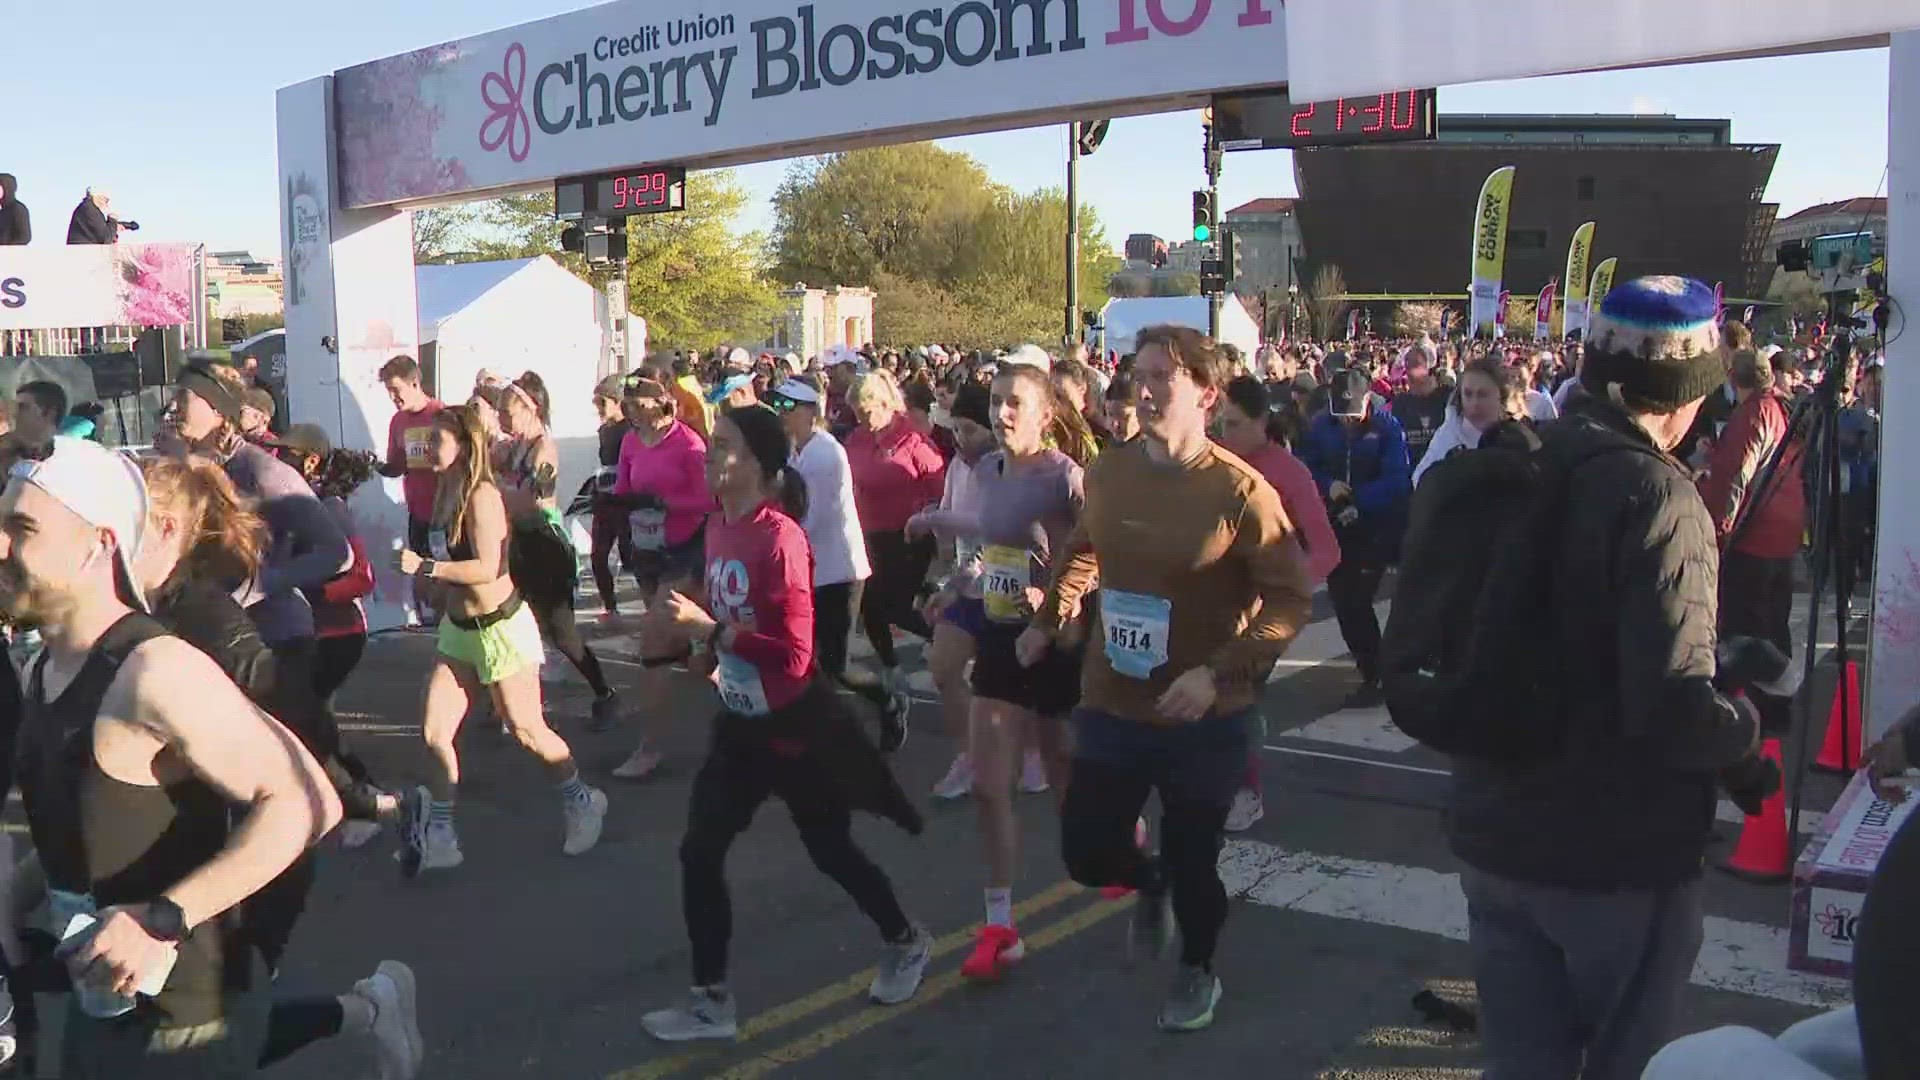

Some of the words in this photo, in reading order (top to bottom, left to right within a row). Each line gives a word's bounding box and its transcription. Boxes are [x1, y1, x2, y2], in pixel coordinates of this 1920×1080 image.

[532, 44, 739, 137] Cherry
[749, 0, 1088, 101] Blossom
[593, 25, 662, 62] Credit
[666, 12, 736, 48] Union
